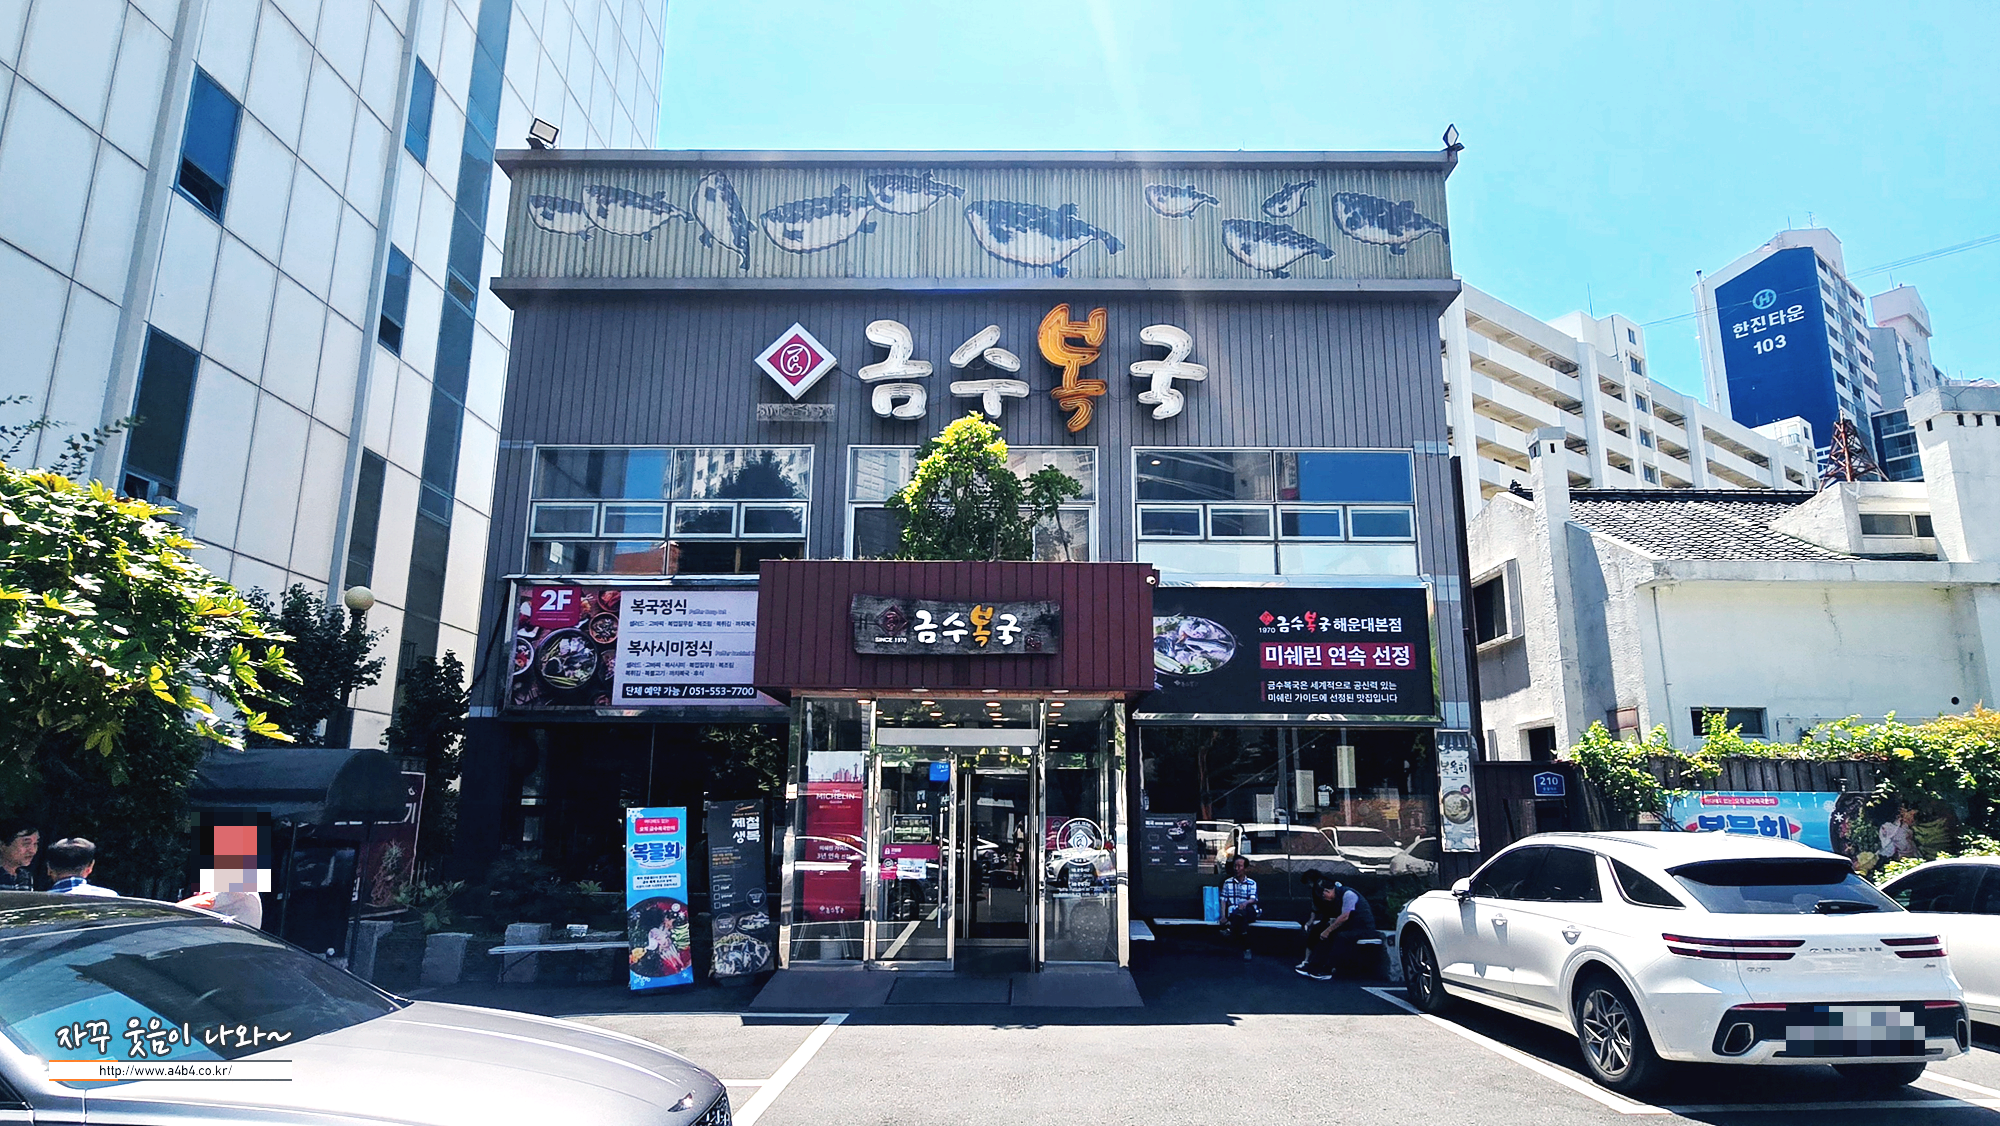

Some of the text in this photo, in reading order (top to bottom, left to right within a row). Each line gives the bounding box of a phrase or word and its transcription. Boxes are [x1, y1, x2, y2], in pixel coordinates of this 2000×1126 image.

[1732, 304, 1805, 339] 한진타운
[1754, 334, 1787, 354] 103
[858, 303, 1208, 432] 금수복국
[539, 590, 572, 610] 2F
[630, 599, 687, 615] 복국정식
[914, 604, 1022, 647] 금수복국
[1276, 611, 1402, 633] 금수복국 해운대본점
[627, 640, 713, 656] 복사시미정식
[1266, 646, 1410, 666] 미쉐린 연속 선정
[626, 686, 642, 696] 단체
[644, 686, 661, 696] 예약
[664, 686, 680, 696] 가능
[689, 686, 754, 696] 051-553-7700
[1268, 681, 1397, 690] 금수복국은 세계적으로 공신력 있는
[1268, 693, 1398, 703] 미쉐린 가이드에 선정된 맛집입니다
[1540, 777, 1558, 785] 210
[732, 816, 759, 829] 제철
[633, 842, 679, 860] 복물회
